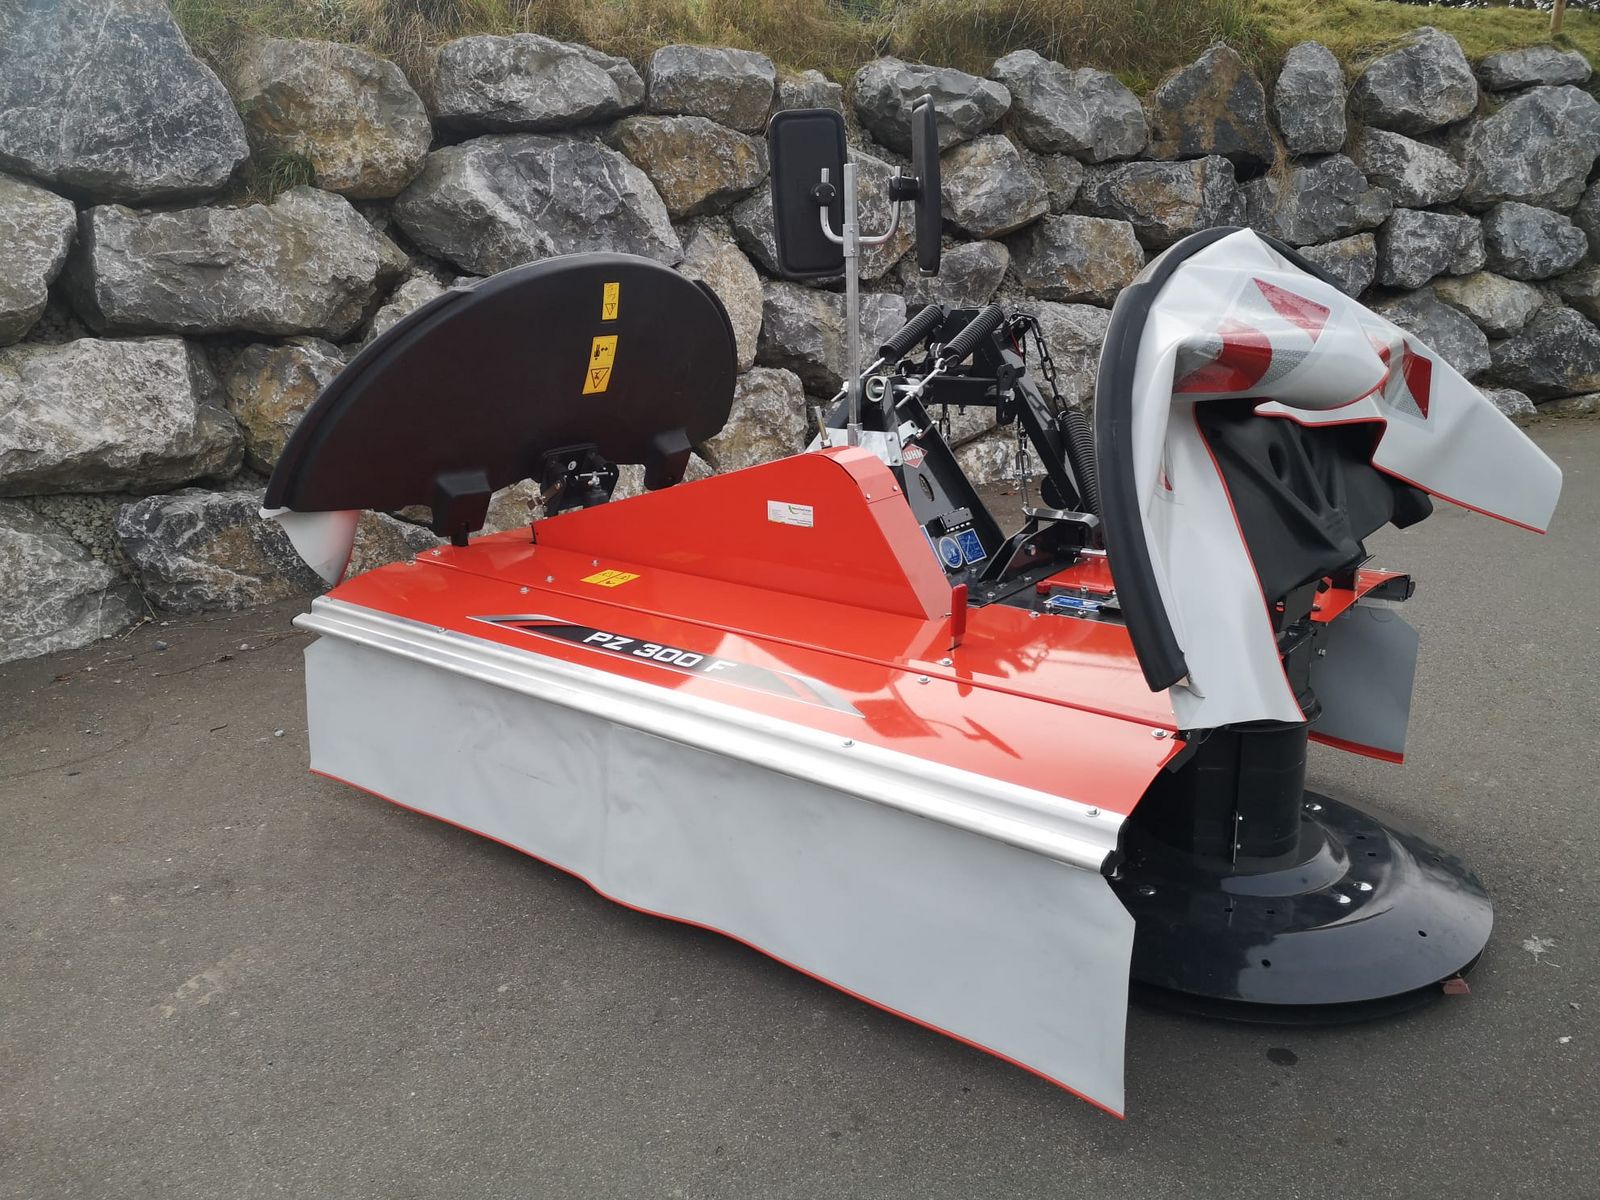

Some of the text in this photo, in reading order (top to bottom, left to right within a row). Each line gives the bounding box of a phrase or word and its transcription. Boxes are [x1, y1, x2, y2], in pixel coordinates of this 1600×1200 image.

[582, 631, 737, 673] PZ 300 F
